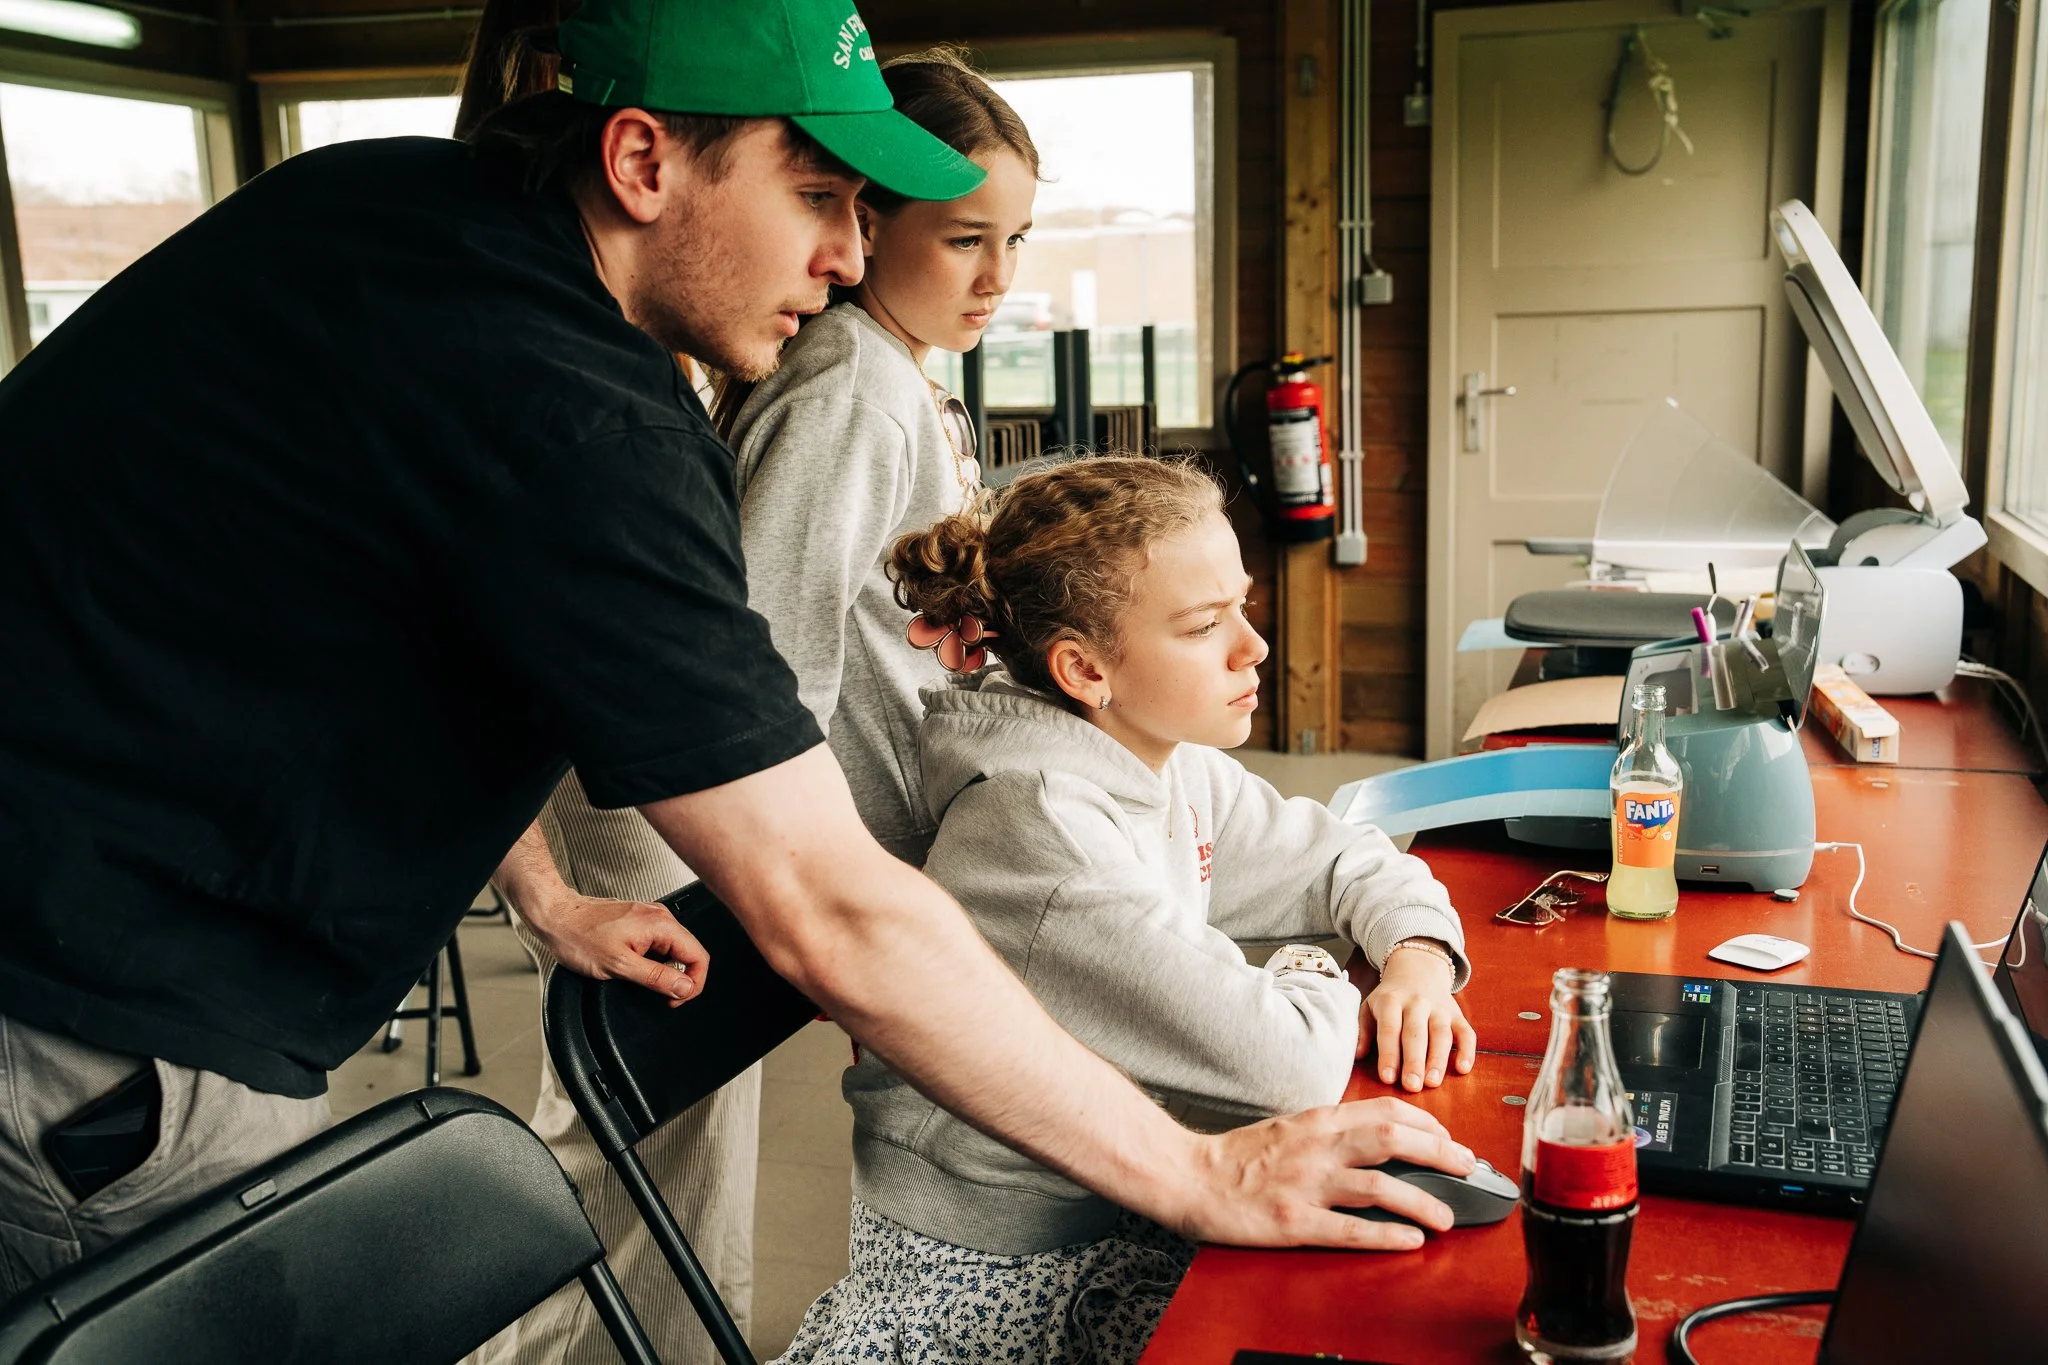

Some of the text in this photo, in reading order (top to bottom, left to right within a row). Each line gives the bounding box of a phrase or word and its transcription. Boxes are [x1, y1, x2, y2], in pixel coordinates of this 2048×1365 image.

[833, 24, 855, 70] SAN
[1625, 799, 1675, 820] FANTA
[1618, 821, 1624, 833] ME
[1658, 1099, 1672, 1121] KATANA
